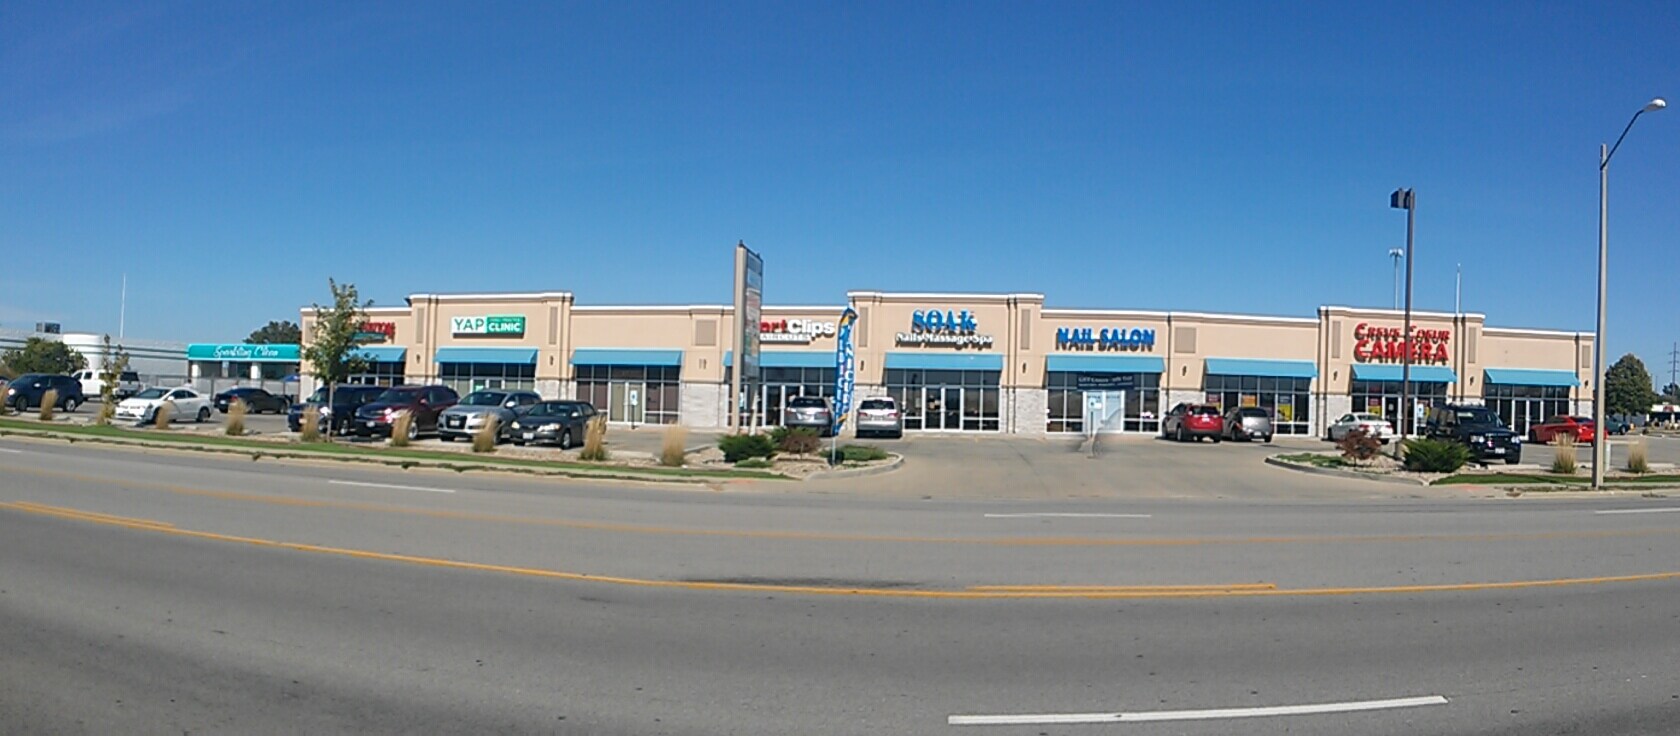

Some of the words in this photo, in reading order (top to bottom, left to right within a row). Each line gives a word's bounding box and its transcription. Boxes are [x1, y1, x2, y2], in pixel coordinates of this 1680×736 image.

[454, 317, 485, 331] YAP
[488, 322, 520, 333] CLINIC
[912, 309, 977, 331] SOAK
[1057, 327, 1095, 345] NAIL
[1099, 327, 1155, 347] SALON
[1354, 339, 1449, 361] CAMERA
